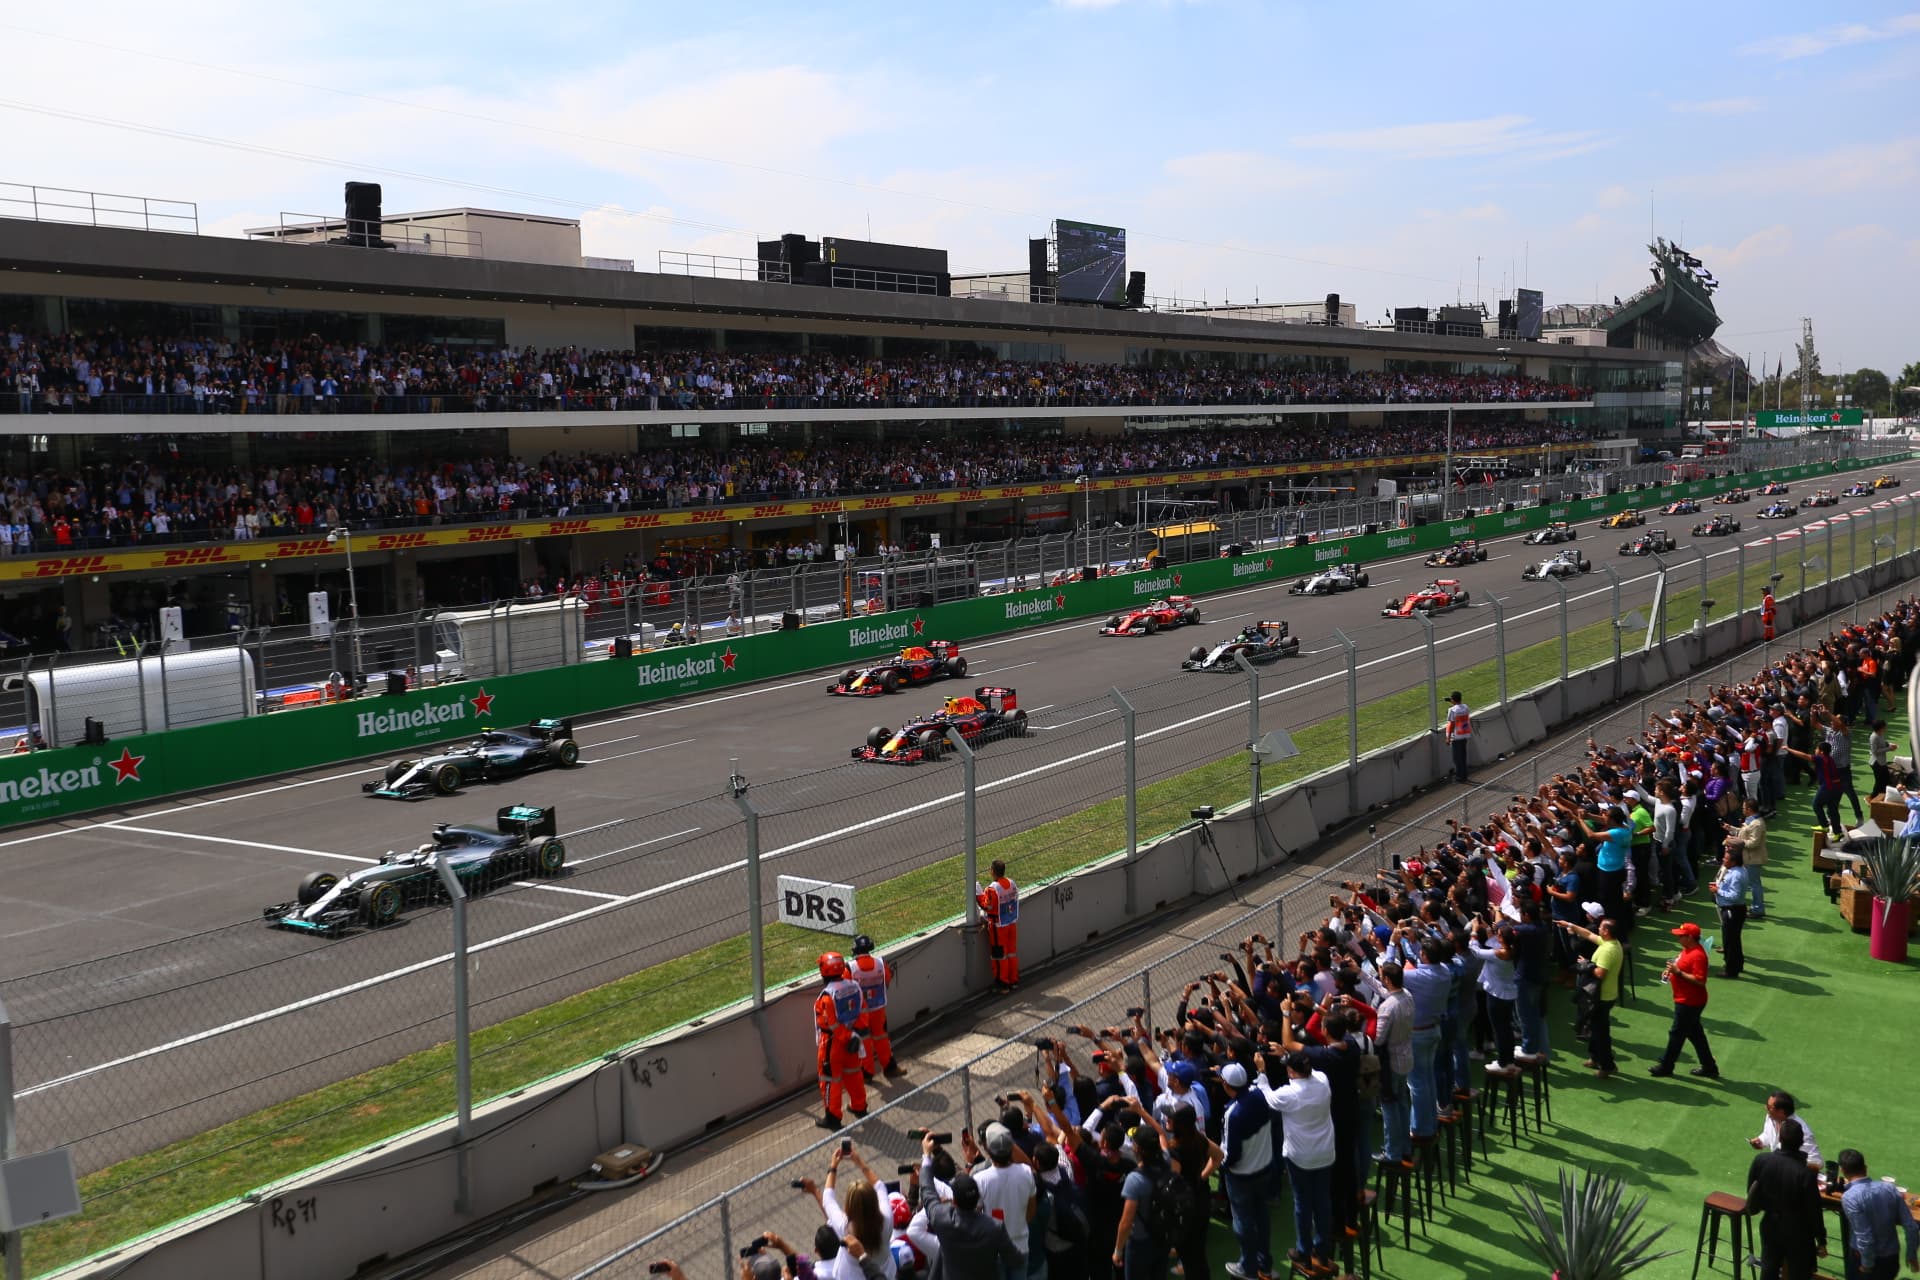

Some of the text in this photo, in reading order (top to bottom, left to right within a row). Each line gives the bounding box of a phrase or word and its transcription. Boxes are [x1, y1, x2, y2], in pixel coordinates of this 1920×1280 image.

[1693, 401, 1700, 411] A
[1702, 400, 1710, 411] A
[913, 493, 939, 504] DHL
[960, 490, 983, 500] DHL
[1002, 488, 1025, 497] DHL
[811, 501, 843, 513] DHL
[864, 497, 892, 508] DHL
[692, 510, 726, 522] DHL
[753, 504, 786, 518] DHL
[550, 520, 591, 534] DHL
[624, 515, 662, 529] DHL
[378, 533, 428, 549] DHL
[467, 525, 515, 541] DHL
[164, 547, 228, 566] DHL
[276, 540, 335, 557] DHL
[36, 556, 109, 577] DHL
[1233, 561, 1264, 577] Heineken
[1133, 577, 1171, 595] Heineken
[1005, 597, 1052, 619] Heineken
[849, 623, 908, 647] Heineken
[638, 658, 716, 686] Heineken
[357, 702, 465, 737] Heineken
[785, 890, 845, 923] DRS
